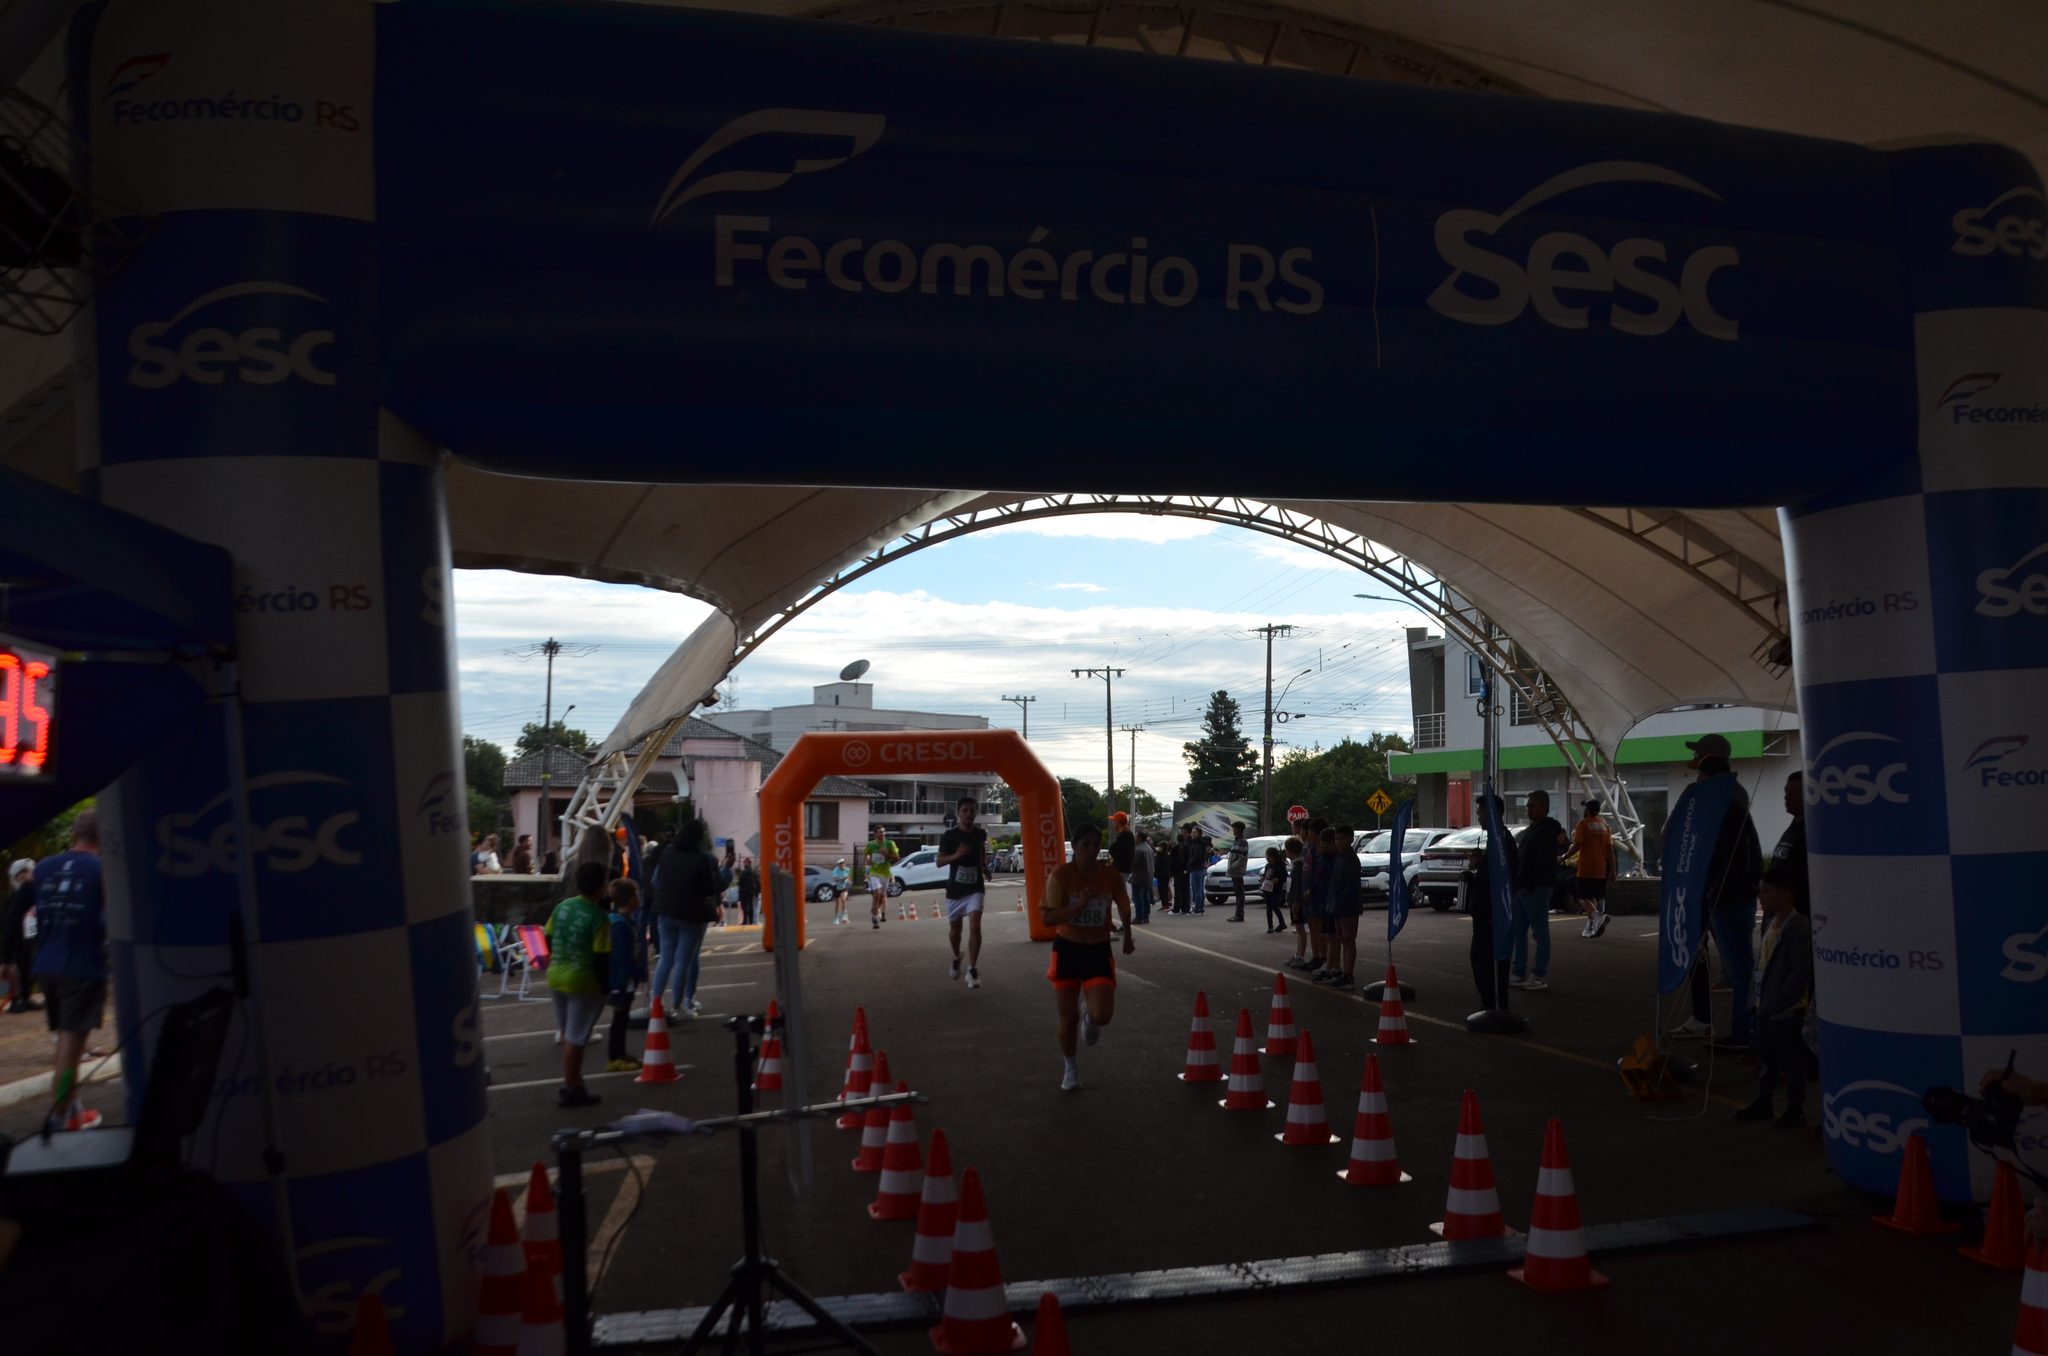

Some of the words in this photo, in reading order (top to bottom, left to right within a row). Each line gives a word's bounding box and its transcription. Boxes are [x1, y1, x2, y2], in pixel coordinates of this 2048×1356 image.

[113, 92, 303, 127] Fecomércio
[316, 101, 359, 131] RS
[714, 214, 1200, 308] Fecomércio
[1225, 243, 1325, 315] RS
[1426, 208, 1740, 341] Sesc
[126, 322, 336, 388] Sesc
[236, 586, 320, 613] ércio
[328, 584, 371, 612] RS
[1803, 596, 1876, 624] omércio
[1882, 591, 1919, 614] RS
[879, 741, 983, 762] CRESOL
[156, 812, 361, 877] Sesc
[1907, 949, 1945, 971] RS
[365, 1050, 408, 1081] RS
